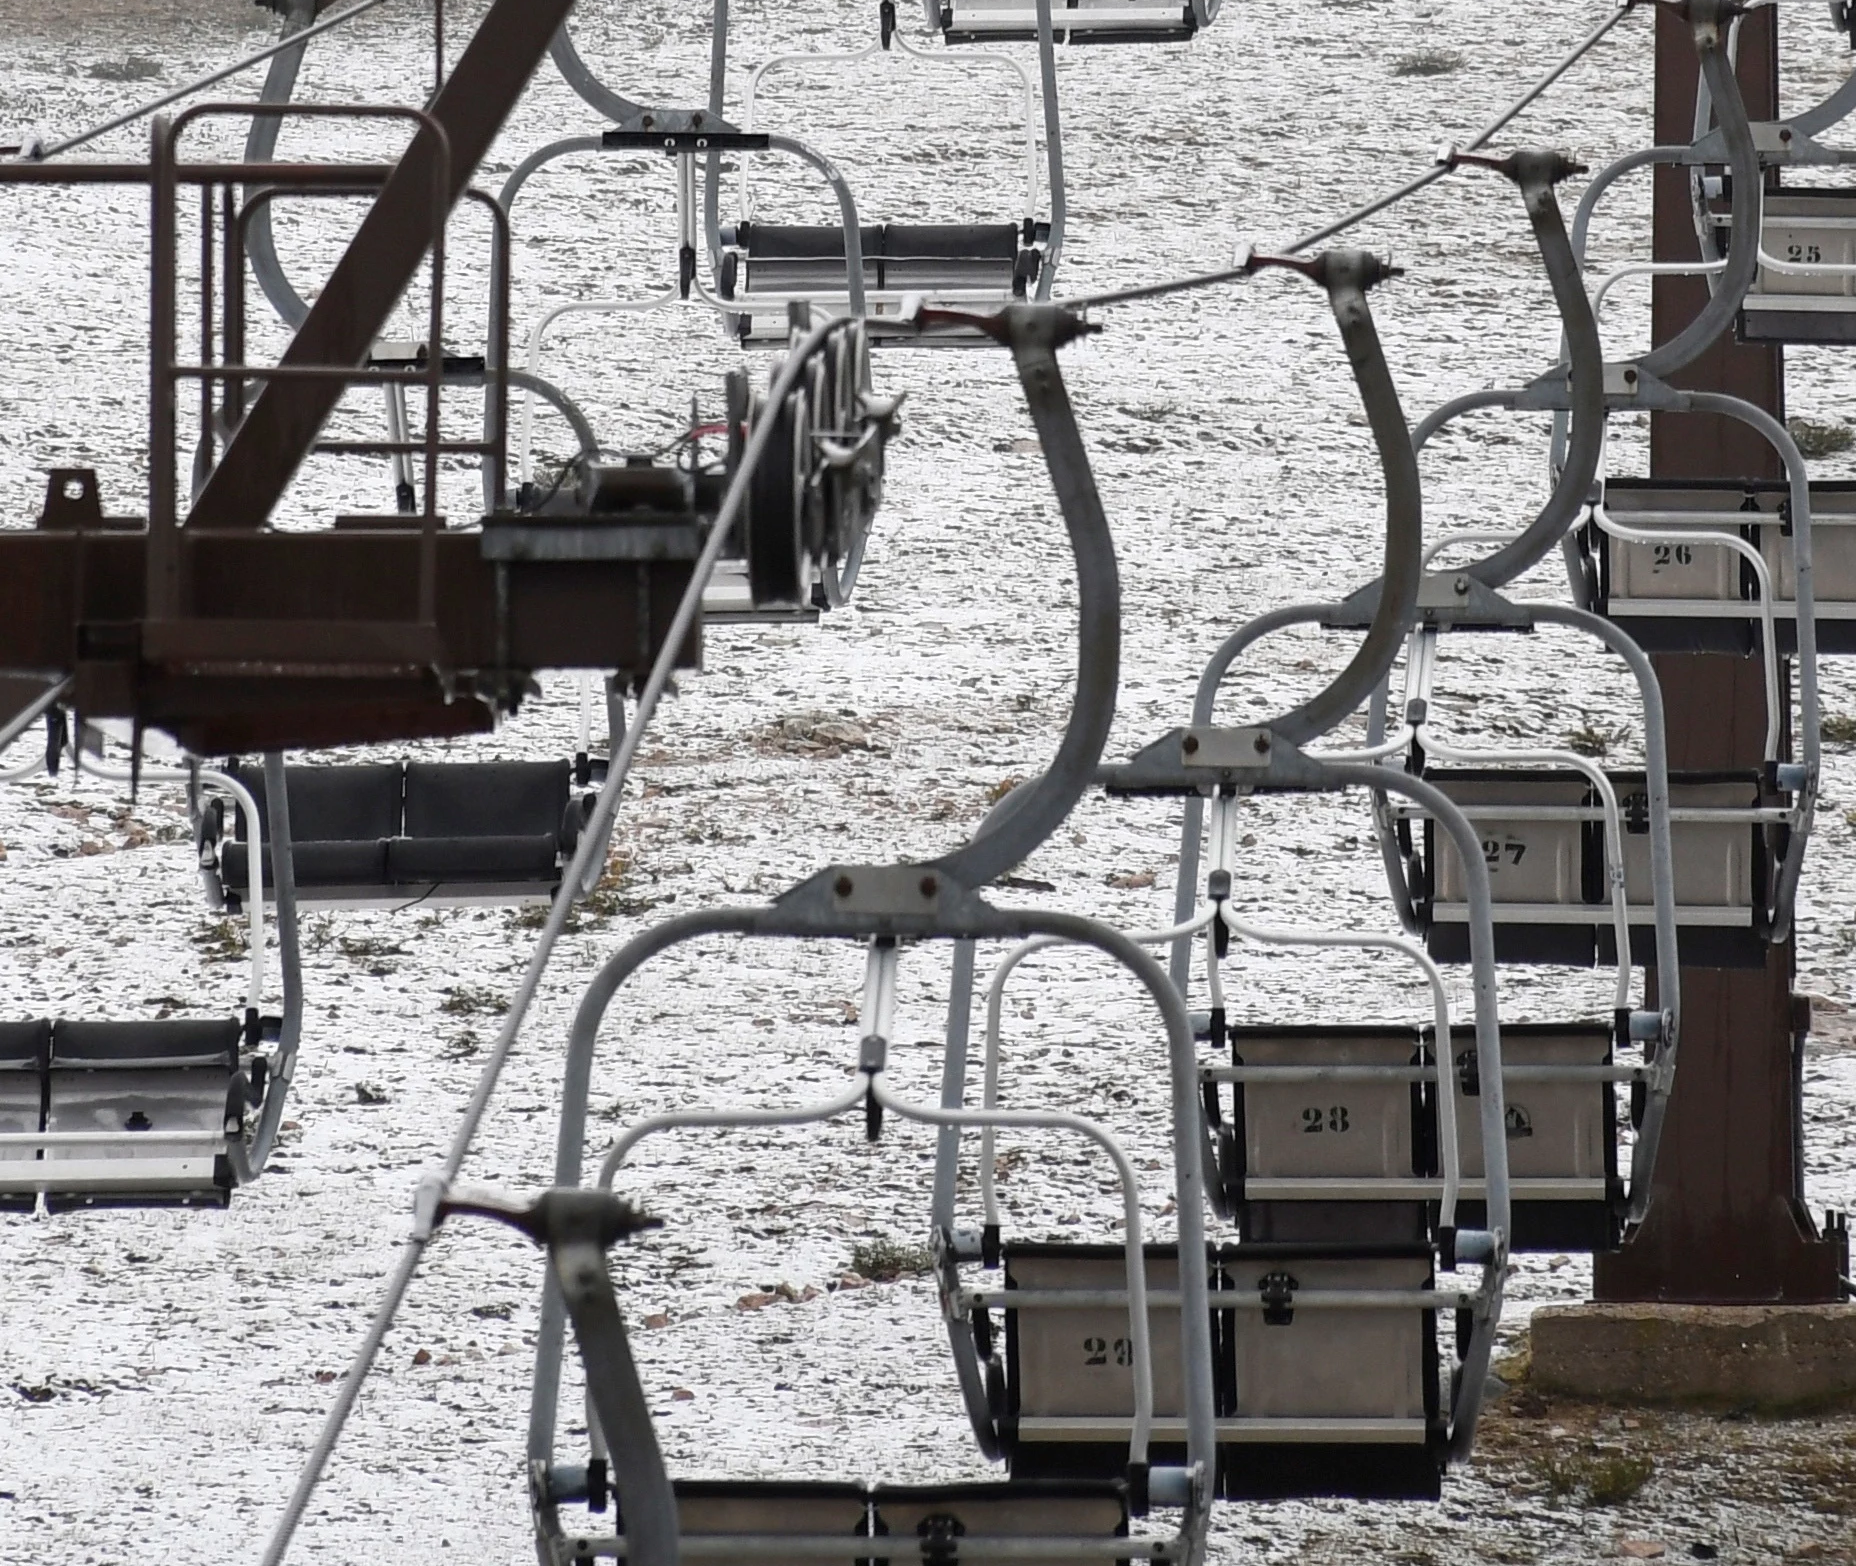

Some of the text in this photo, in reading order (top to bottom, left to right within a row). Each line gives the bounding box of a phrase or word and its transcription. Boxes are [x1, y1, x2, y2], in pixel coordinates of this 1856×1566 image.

[1788, 245, 1821, 263] 25
[1654, 545, 1692, 565] 26
[1482, 840, 1526, 865] 27
[1302, 1106, 1350, 1133] 28
[1083, 1337, 1133, 1366] 29
